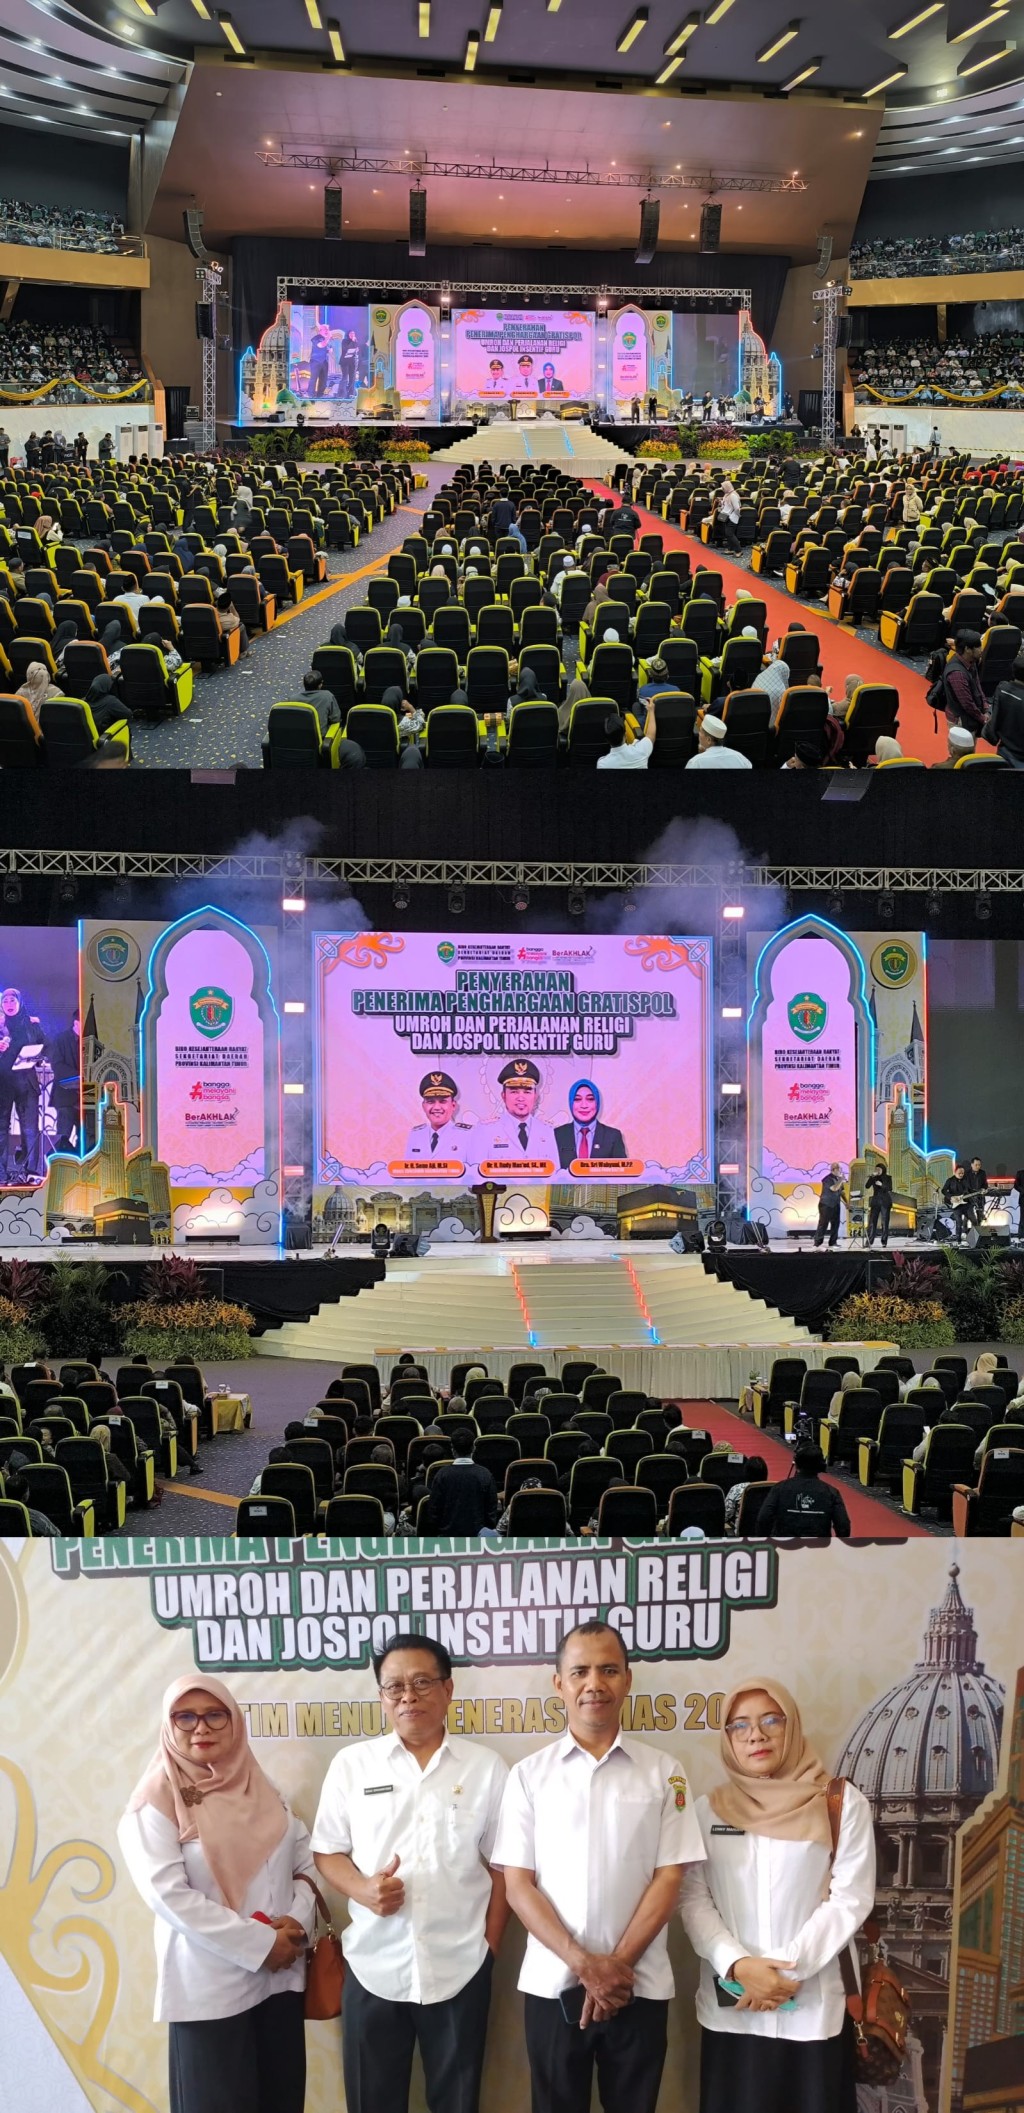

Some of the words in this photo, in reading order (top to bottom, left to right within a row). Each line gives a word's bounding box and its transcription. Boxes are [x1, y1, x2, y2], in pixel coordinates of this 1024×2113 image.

[457, 971, 570, 992] PENYERAHAN
[352, 991, 443, 1012] PENERIMA
[446, 992, 574, 1013] PENGHARGAAN
[577, 992, 673, 1014] GRATISPOL
[395, 1016, 450, 1032] UMROH
[455, 1016, 486, 1032] DAN
[489, 1016, 579, 1033] PERJALANAN
[584, 1016, 629, 1033] RELIGI
[413, 1033, 442, 1050] DAN
[446, 1033, 500, 1050] JOSPOL
[505, 1034, 569, 1050] INSENTIF
[573, 1034, 614, 1050] GURU
[153, 1571, 290, 1620] UMROH
[302, 1568, 376, 1614] DAN
[386, 1558, 628, 1611] PERJALANAN
[637, 1550, 768, 1604] RELIGI
[198, 1618, 273, 1662] DAN
[608, 1602, 722, 1652] GURU
[447, 1698, 568, 1734] ENERAS
[684, 1692, 726, 1730] 20
